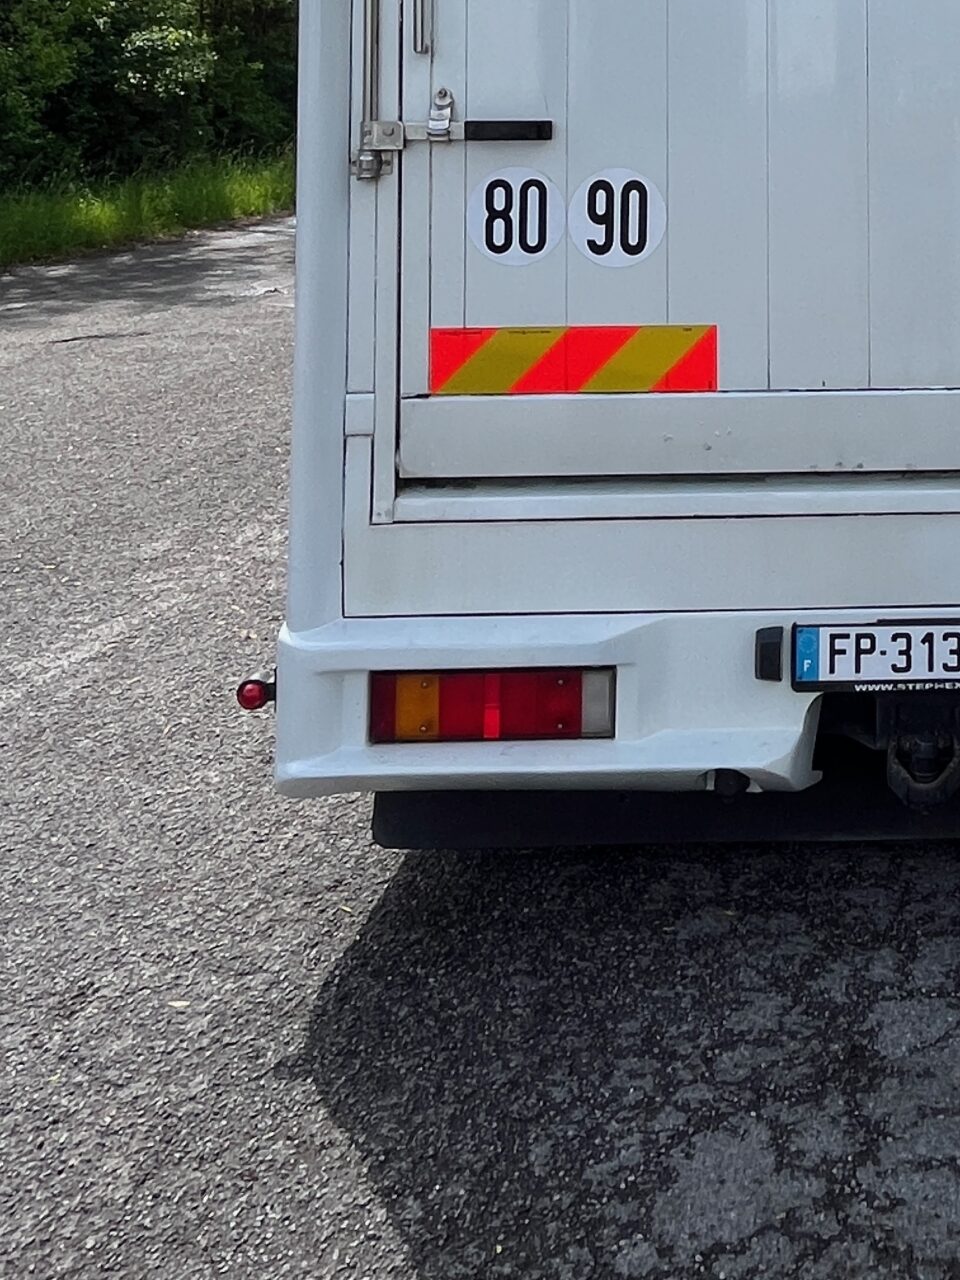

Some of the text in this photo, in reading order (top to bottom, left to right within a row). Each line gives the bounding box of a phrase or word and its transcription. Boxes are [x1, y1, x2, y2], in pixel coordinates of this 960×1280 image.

[485, 179, 547, 254] 80
[587, 180, 648, 255] 90
[803, 659, 812, 672] F
